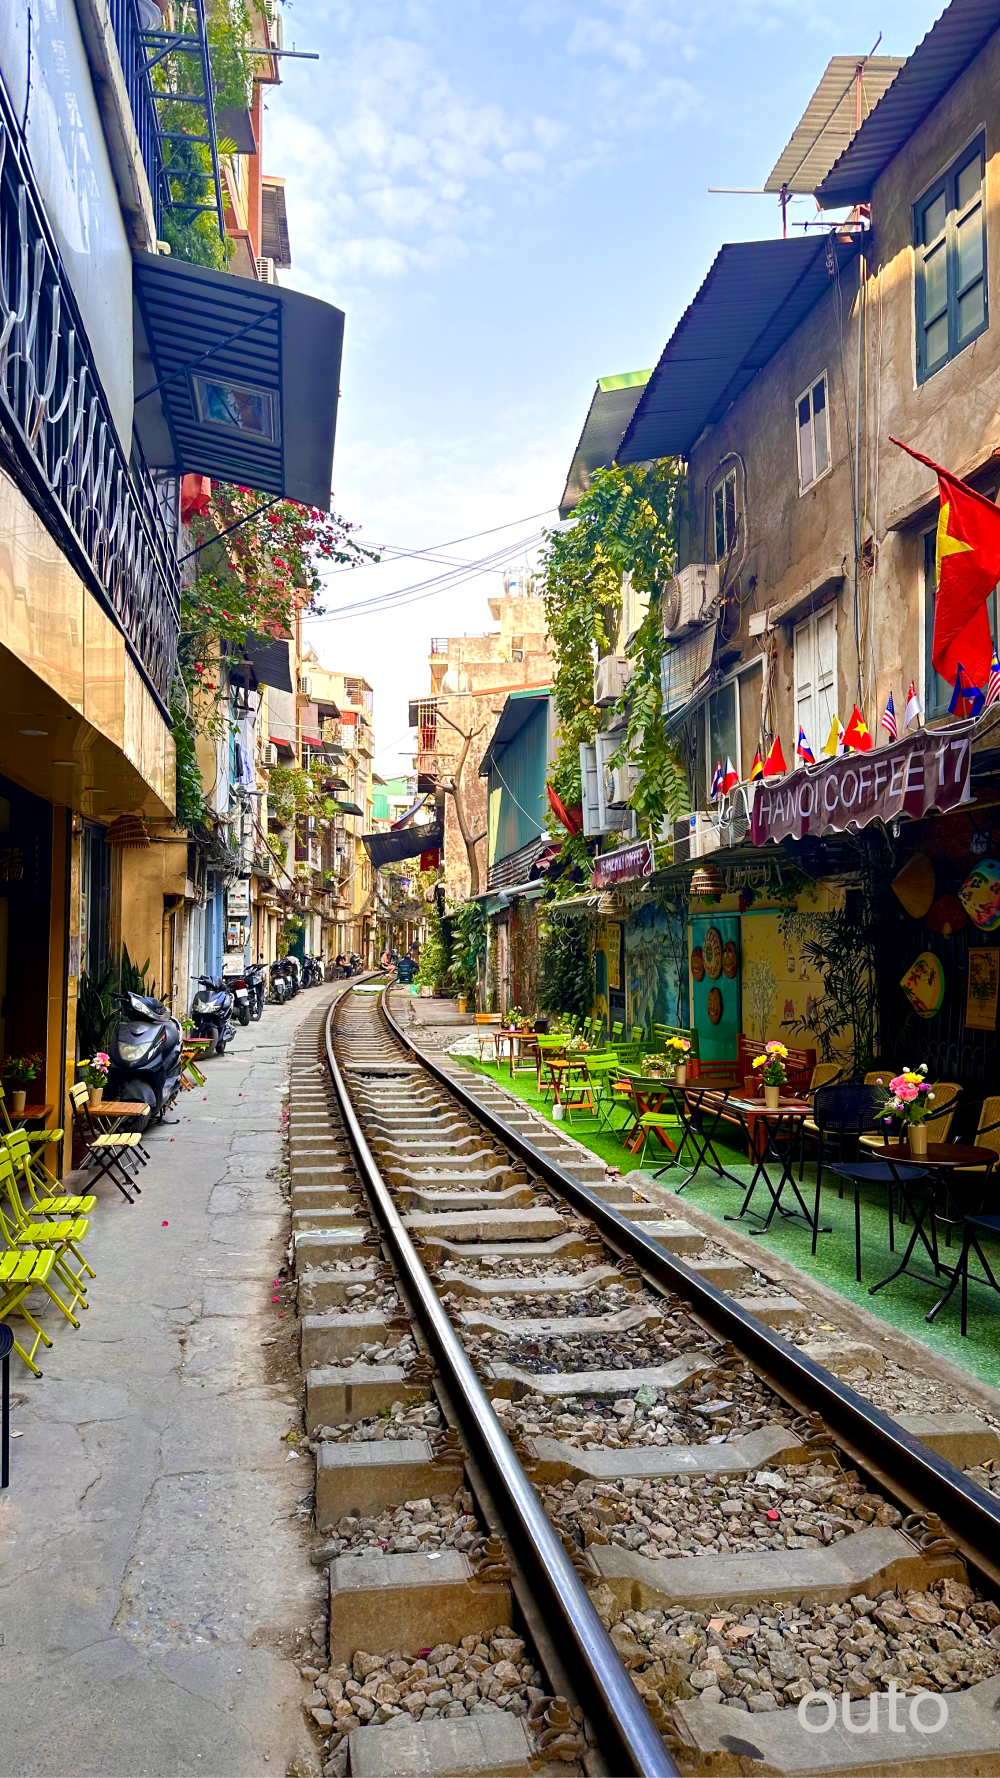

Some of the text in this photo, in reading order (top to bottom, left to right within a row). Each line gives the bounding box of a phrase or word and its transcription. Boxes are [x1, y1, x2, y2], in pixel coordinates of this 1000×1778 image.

[758, 738, 969, 826] HANOI COFFEE 17
[625, 848, 644, 868] COFFEE
